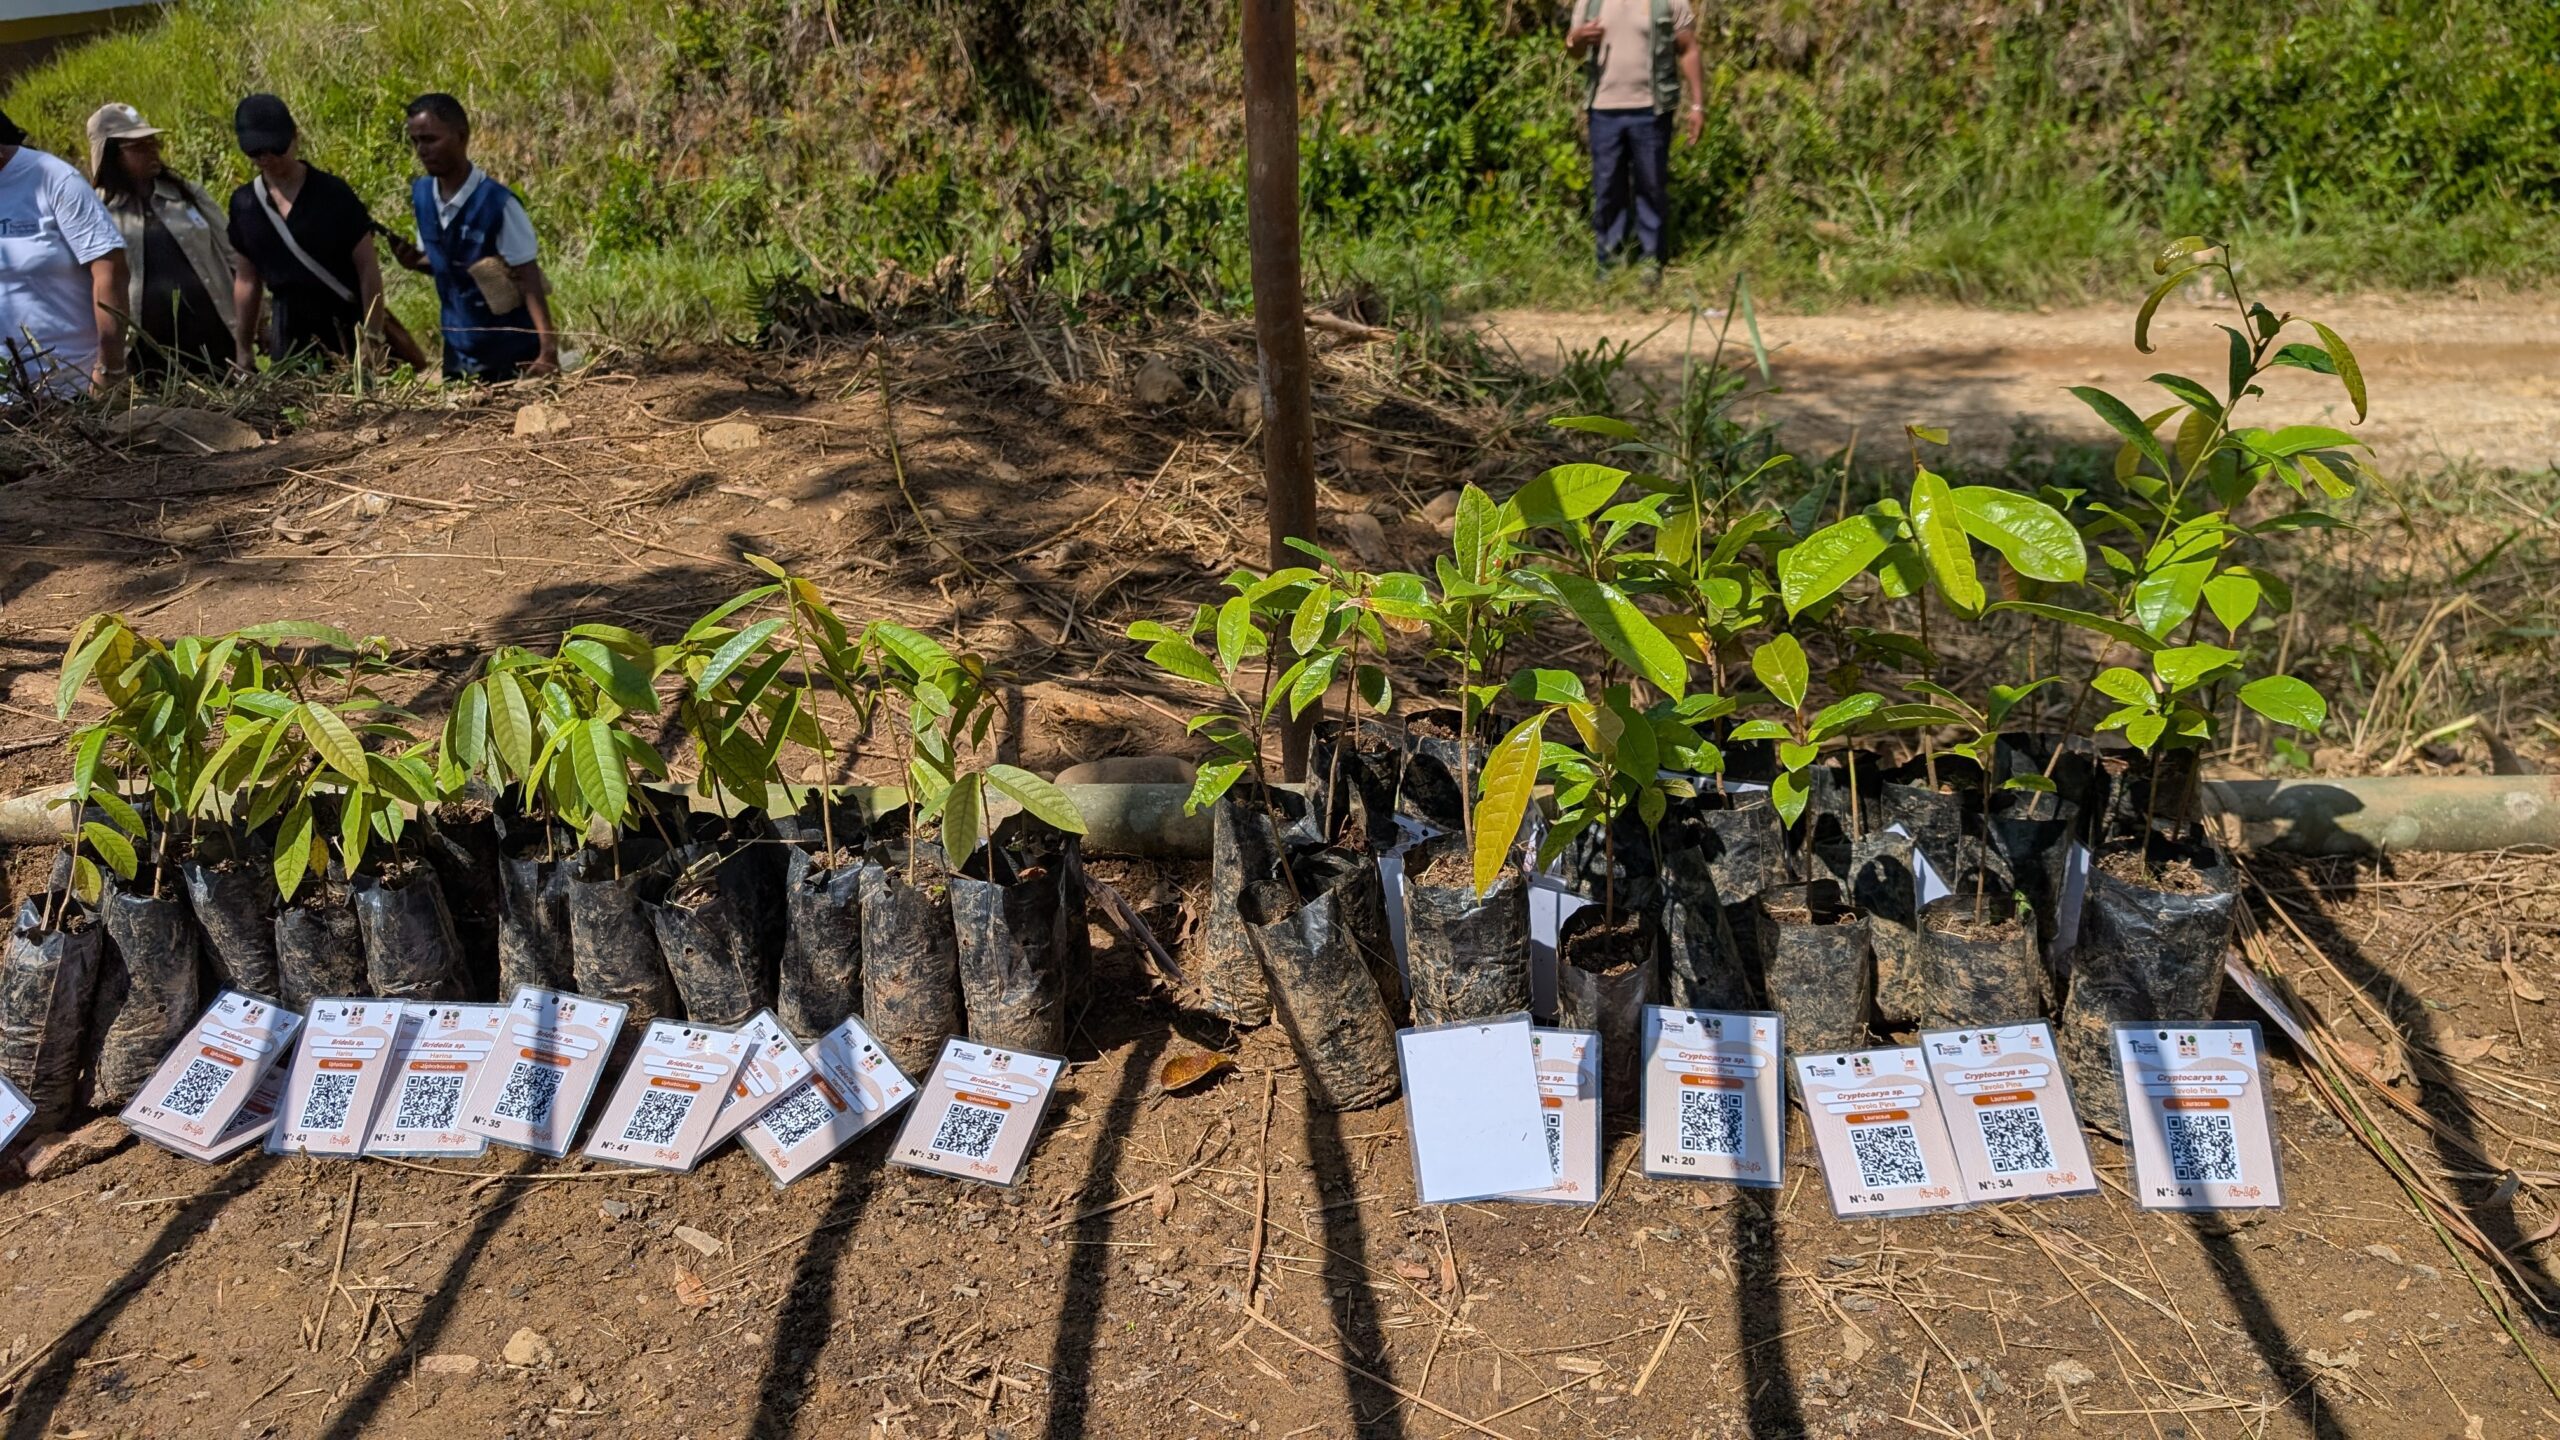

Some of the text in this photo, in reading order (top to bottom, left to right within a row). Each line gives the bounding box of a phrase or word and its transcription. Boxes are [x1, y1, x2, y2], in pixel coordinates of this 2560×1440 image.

[1678, 1051, 1746, 1065] Cryptocarya sp.
[1691, 1065, 1734, 1075] Tavolo Pina
[1964, 1068, 2031, 1081] Cryptocarya sp.
[2157, 1074, 2228, 1083] Cryptocarya sp.
[1979, 1081, 2023, 1091] Tavolo Pina
[1837, 1089, 1904, 1101] Cryptocarya sp.
[1852, 1101, 1896, 1111] Tavolo Pina
[153, 1111, 164, 1120] 17
[488, 1119, 501, 1128] 35
[296, 1134, 307, 1142] 43
[393, 1134, 406, 1142] 31
[617, 1143, 629, 1152] 41
[927, 1152, 941, 1161] 33
[1681, 1156, 1696, 1166] 20
[1998, 1179, 2014, 1189] 34
[2178, 1188, 2193, 1197] 44
[1869, 1193, 1885, 1202] 40
